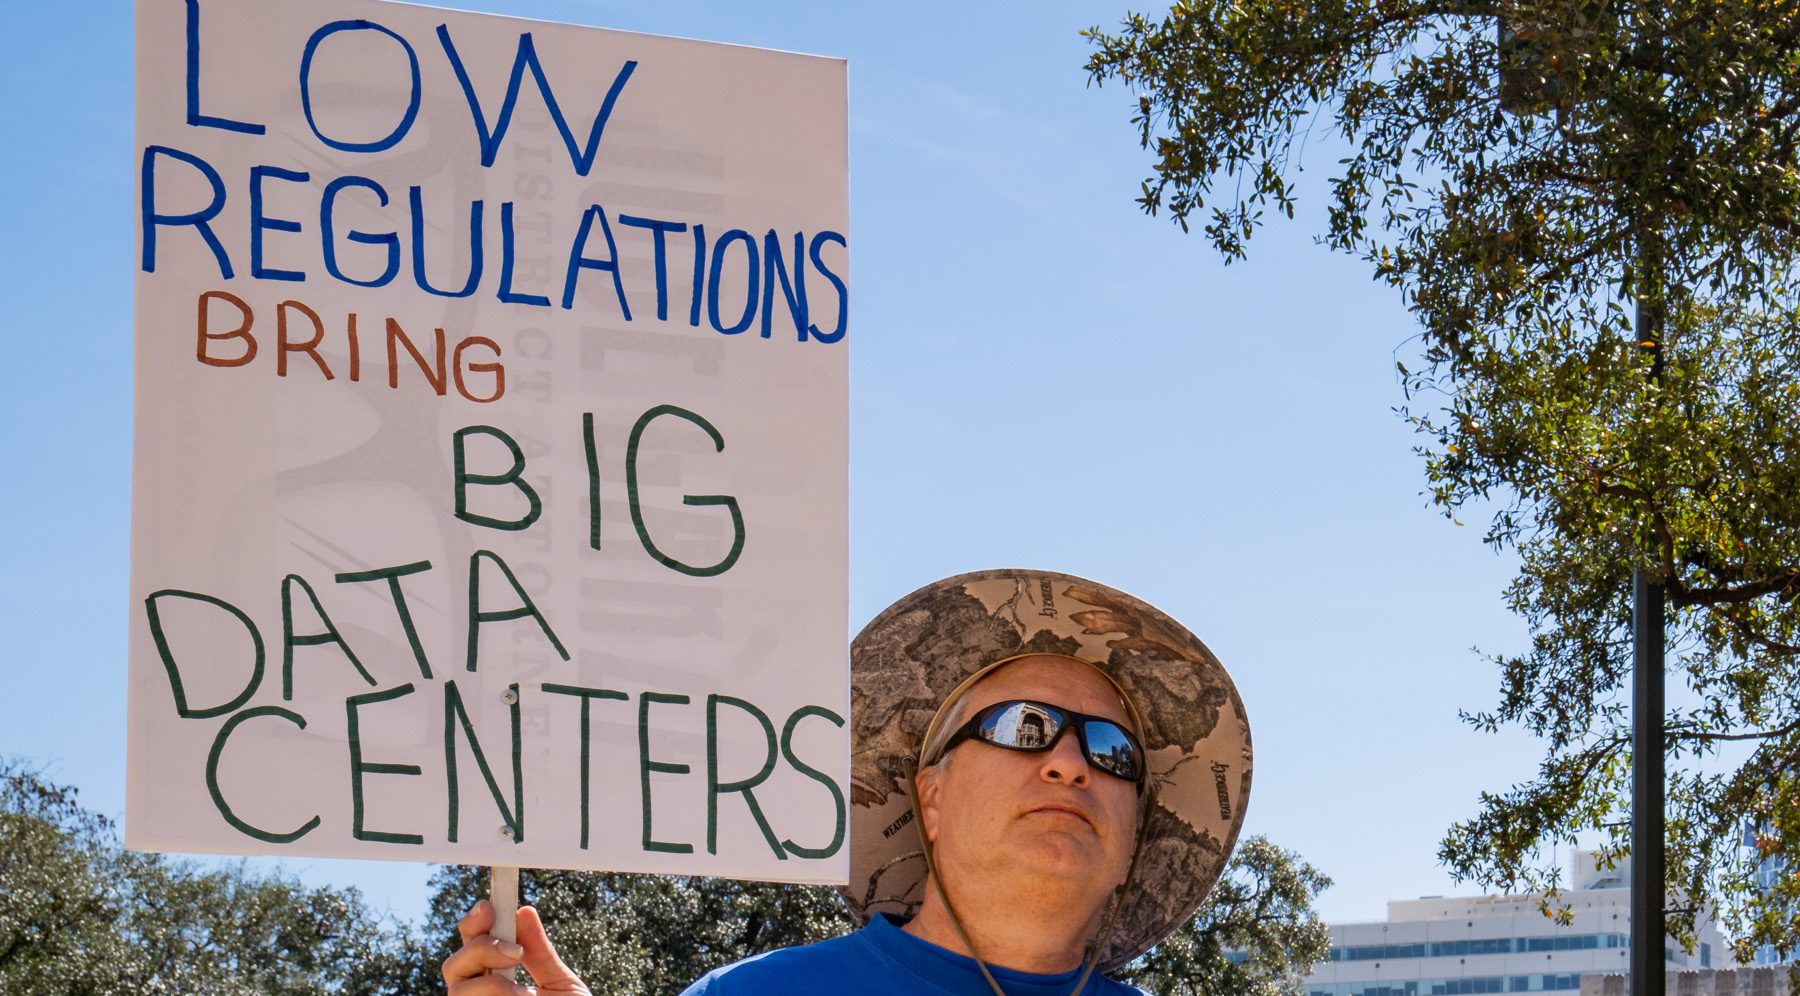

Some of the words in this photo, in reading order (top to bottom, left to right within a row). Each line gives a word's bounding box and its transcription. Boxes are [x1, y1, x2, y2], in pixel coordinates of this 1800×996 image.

[186, 0, 638, 177] LOW
[142, 145, 848, 344] REGULATIONS
[197, 290, 506, 403] BRING
[453, 404, 745, 577] BIG
[147, 550, 570, 719] DATA
[205, 681, 846, 861] CENTERS
